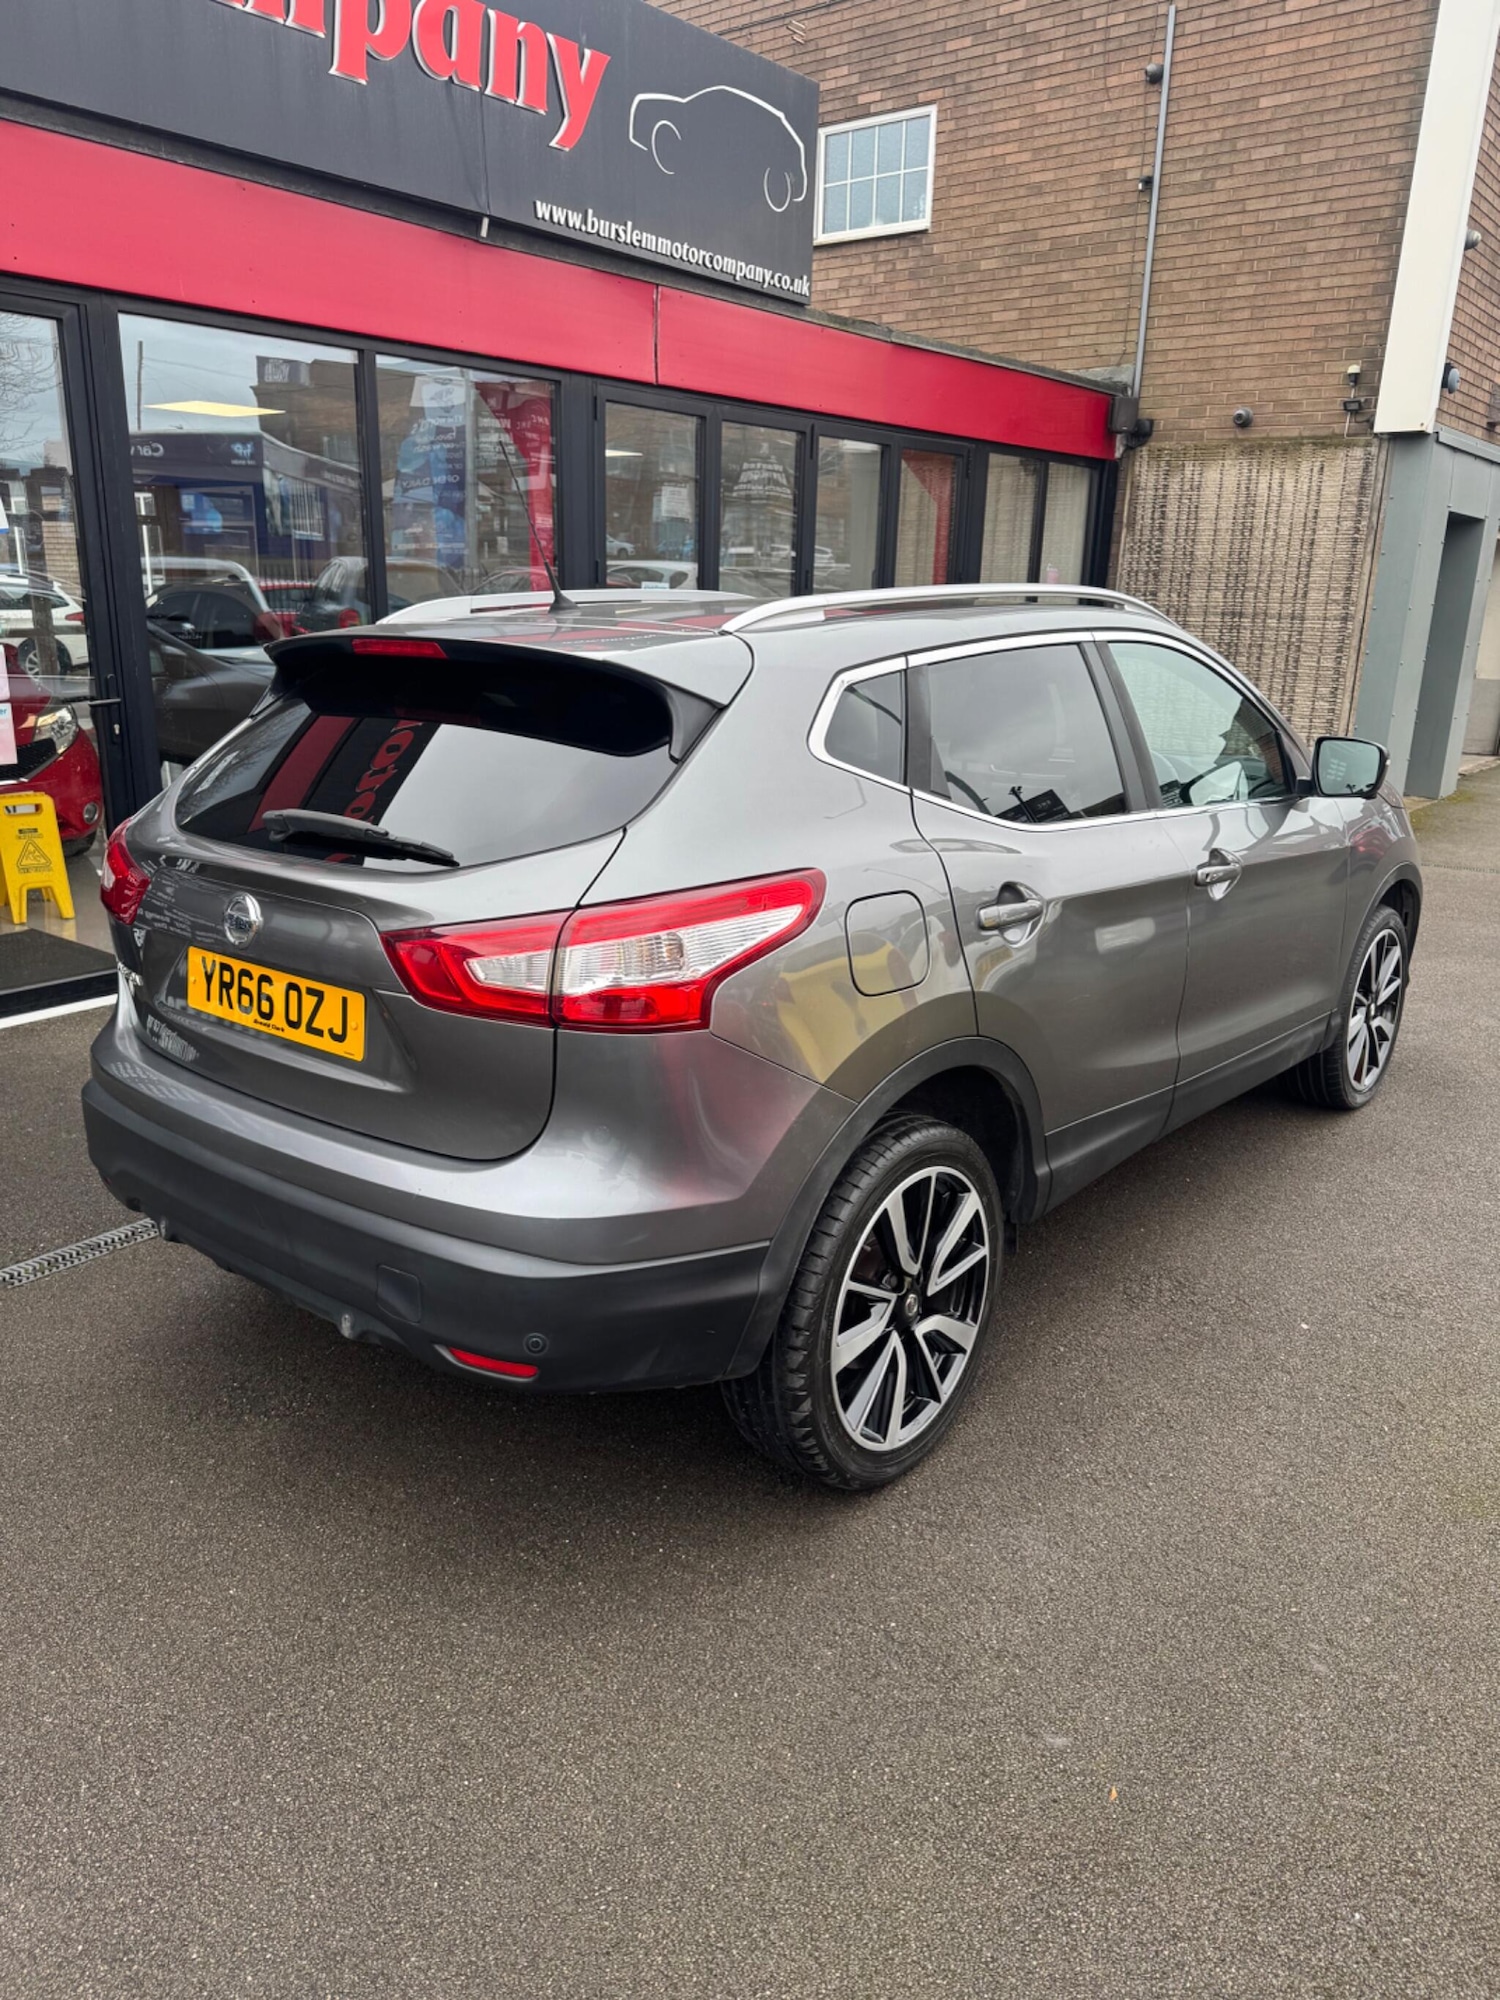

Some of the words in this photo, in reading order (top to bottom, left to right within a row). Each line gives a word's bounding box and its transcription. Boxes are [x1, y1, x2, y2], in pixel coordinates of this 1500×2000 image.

[535, 199, 811, 297] www.burslemmotorcompany.co.uk
[202, 956, 274, 1021] YR66
[285, 981, 348, 1043] OZJ
